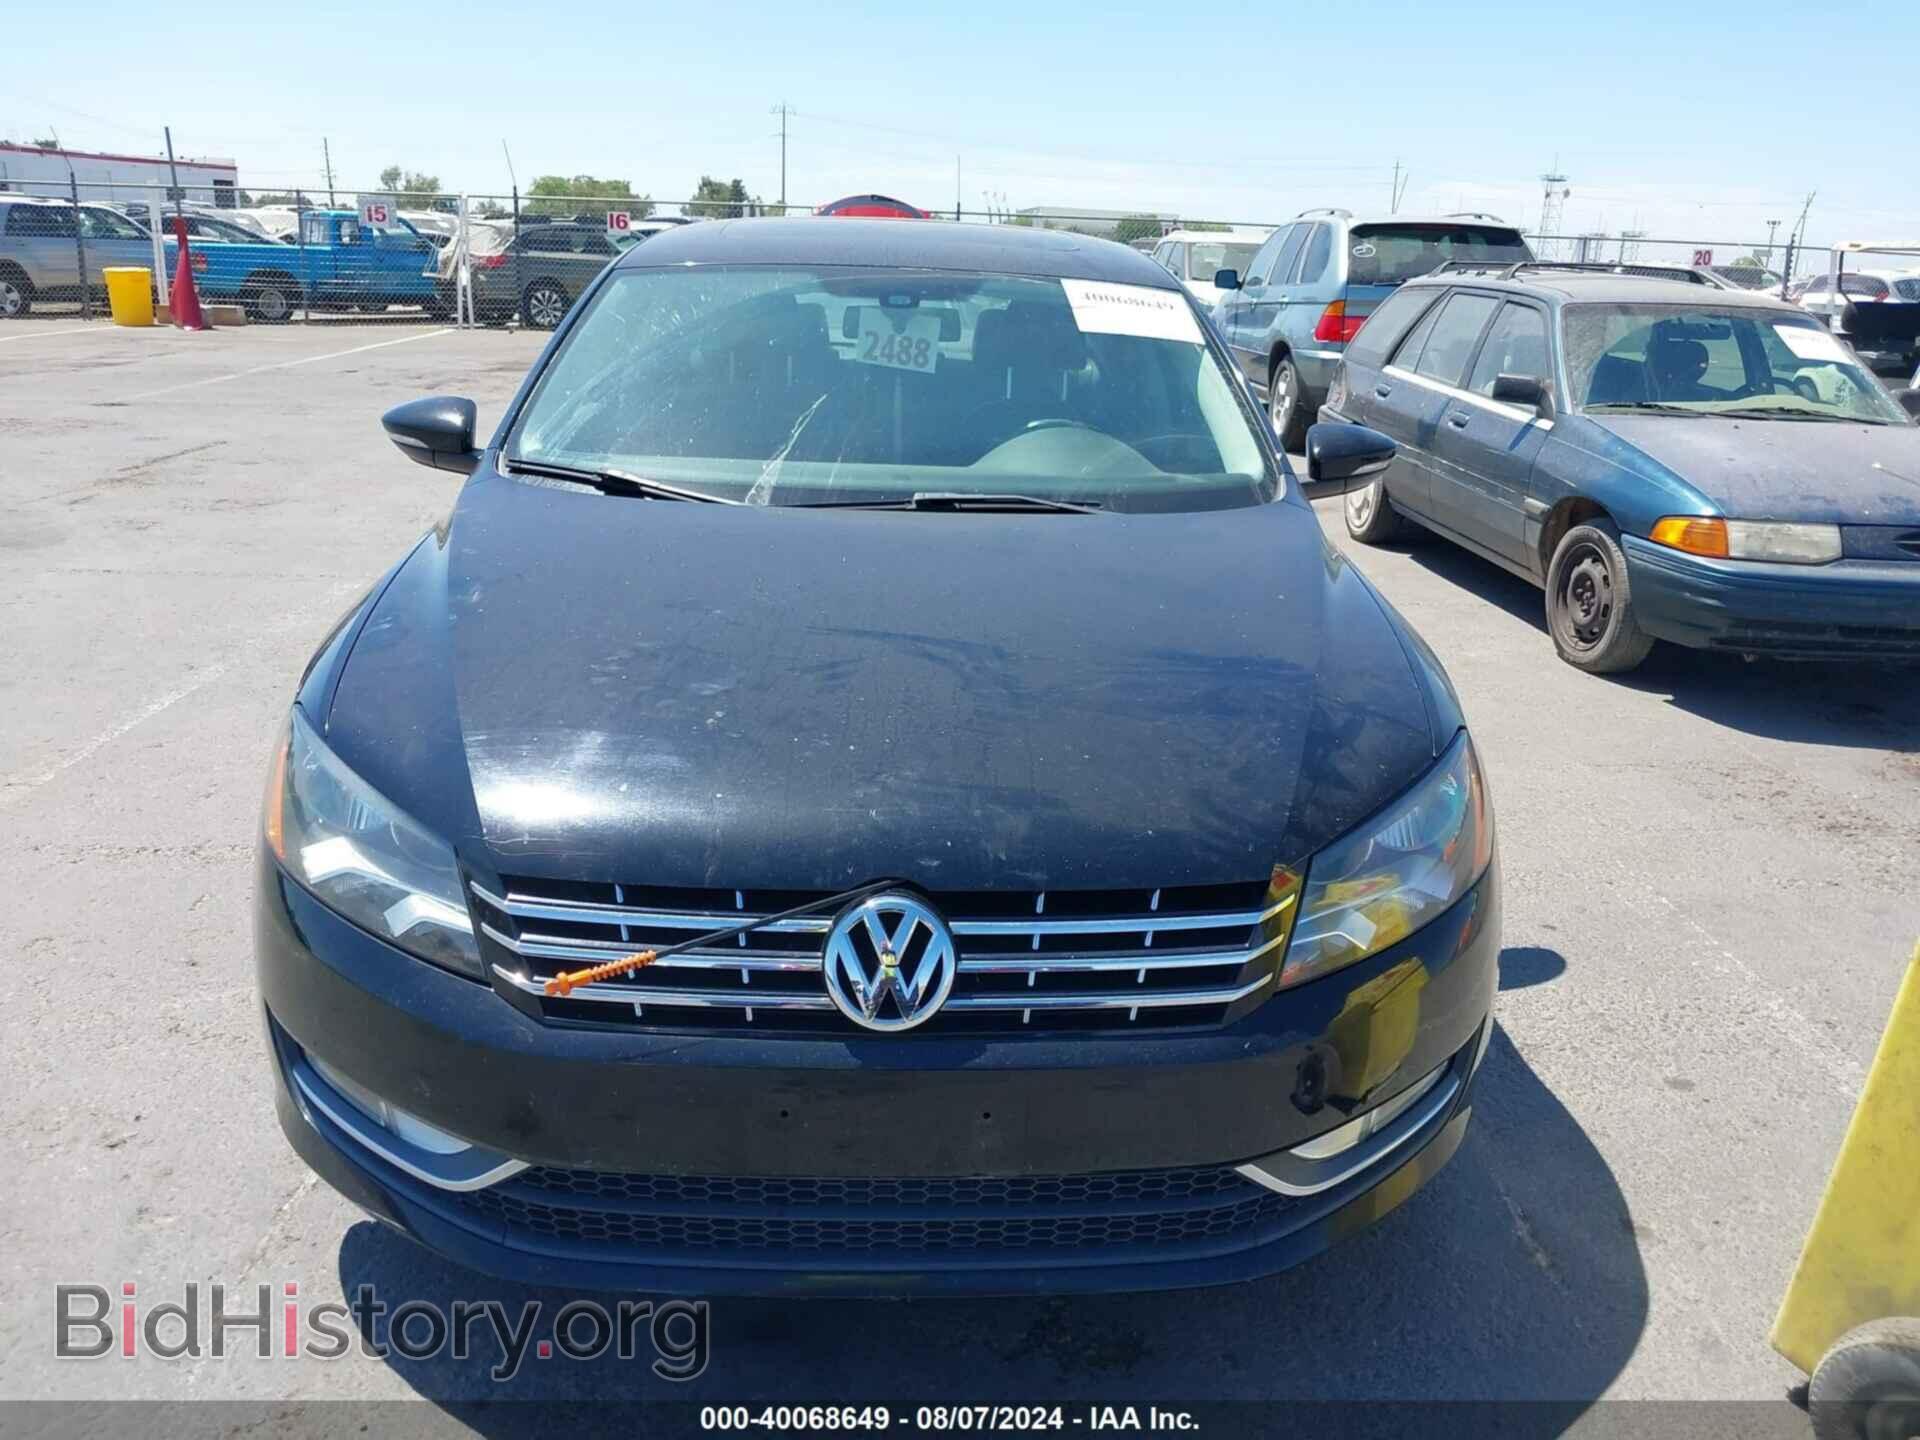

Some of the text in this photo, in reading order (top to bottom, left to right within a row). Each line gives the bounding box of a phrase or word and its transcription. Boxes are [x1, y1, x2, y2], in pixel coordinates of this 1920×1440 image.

[367, 206, 386, 222] 15
[610, 213, 628, 230] 16
[1695, 250, 1711, 266] 20
[863, 330, 931, 369] 2488
